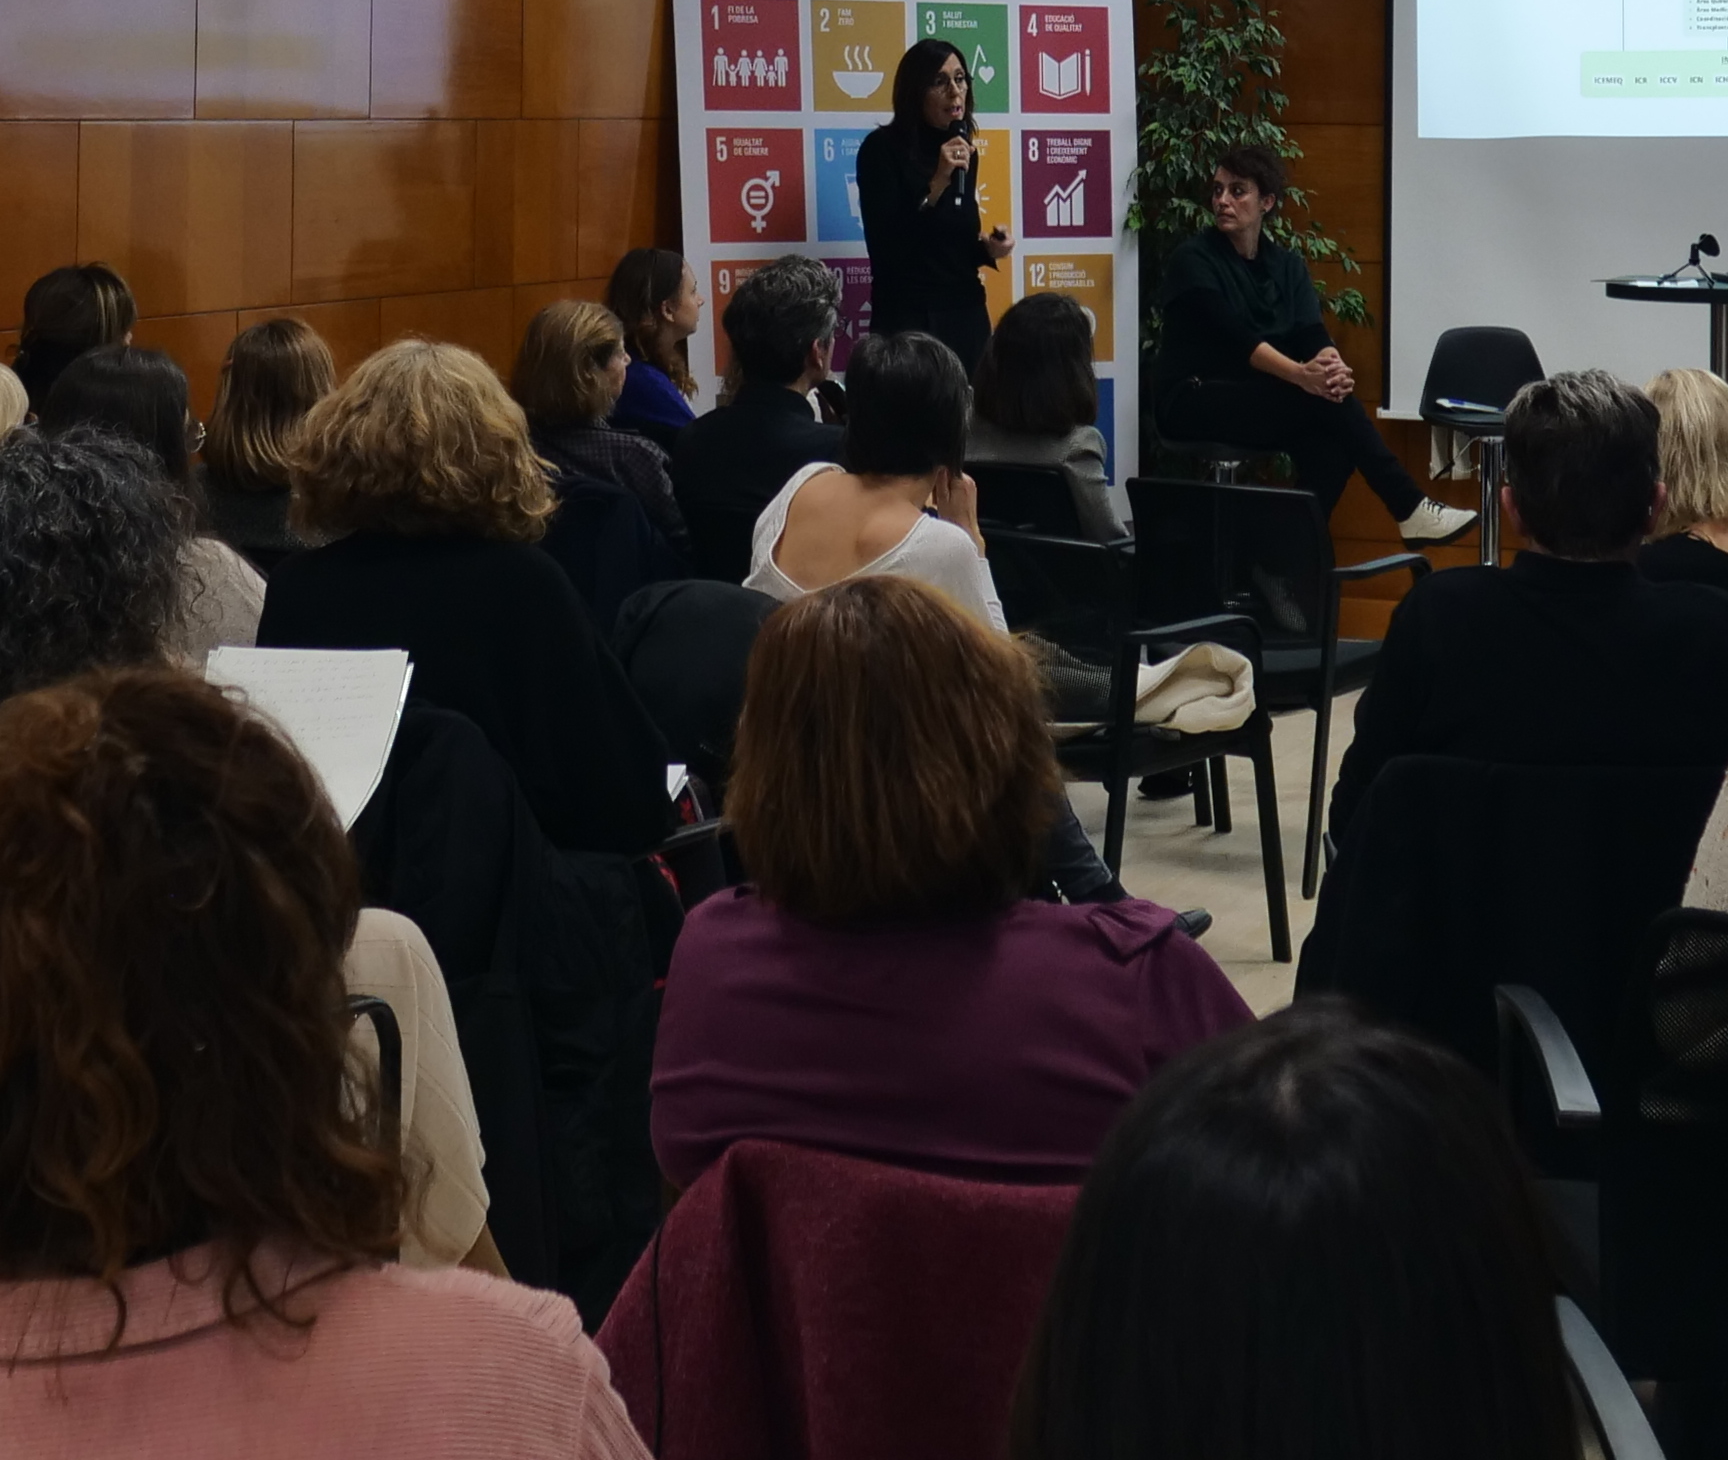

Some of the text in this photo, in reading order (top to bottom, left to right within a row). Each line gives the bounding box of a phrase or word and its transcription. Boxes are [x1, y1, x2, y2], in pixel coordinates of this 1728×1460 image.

[711, 5, 720, 30] 1
[736, 6, 745, 14] DE
[820, 8, 830, 32] 2
[943, 11, 962, 19] SALUT
[926, 11, 936, 35] 3
[1028, 13, 1038, 37] 4
[716, 137, 728, 162] 5
[734, 148, 743, 156] DE
[824, 138, 834, 162] 6
[1029, 138, 1039, 162] 8
[719, 269, 730, 294] 9
[1030, 263, 1046, 287] 12
